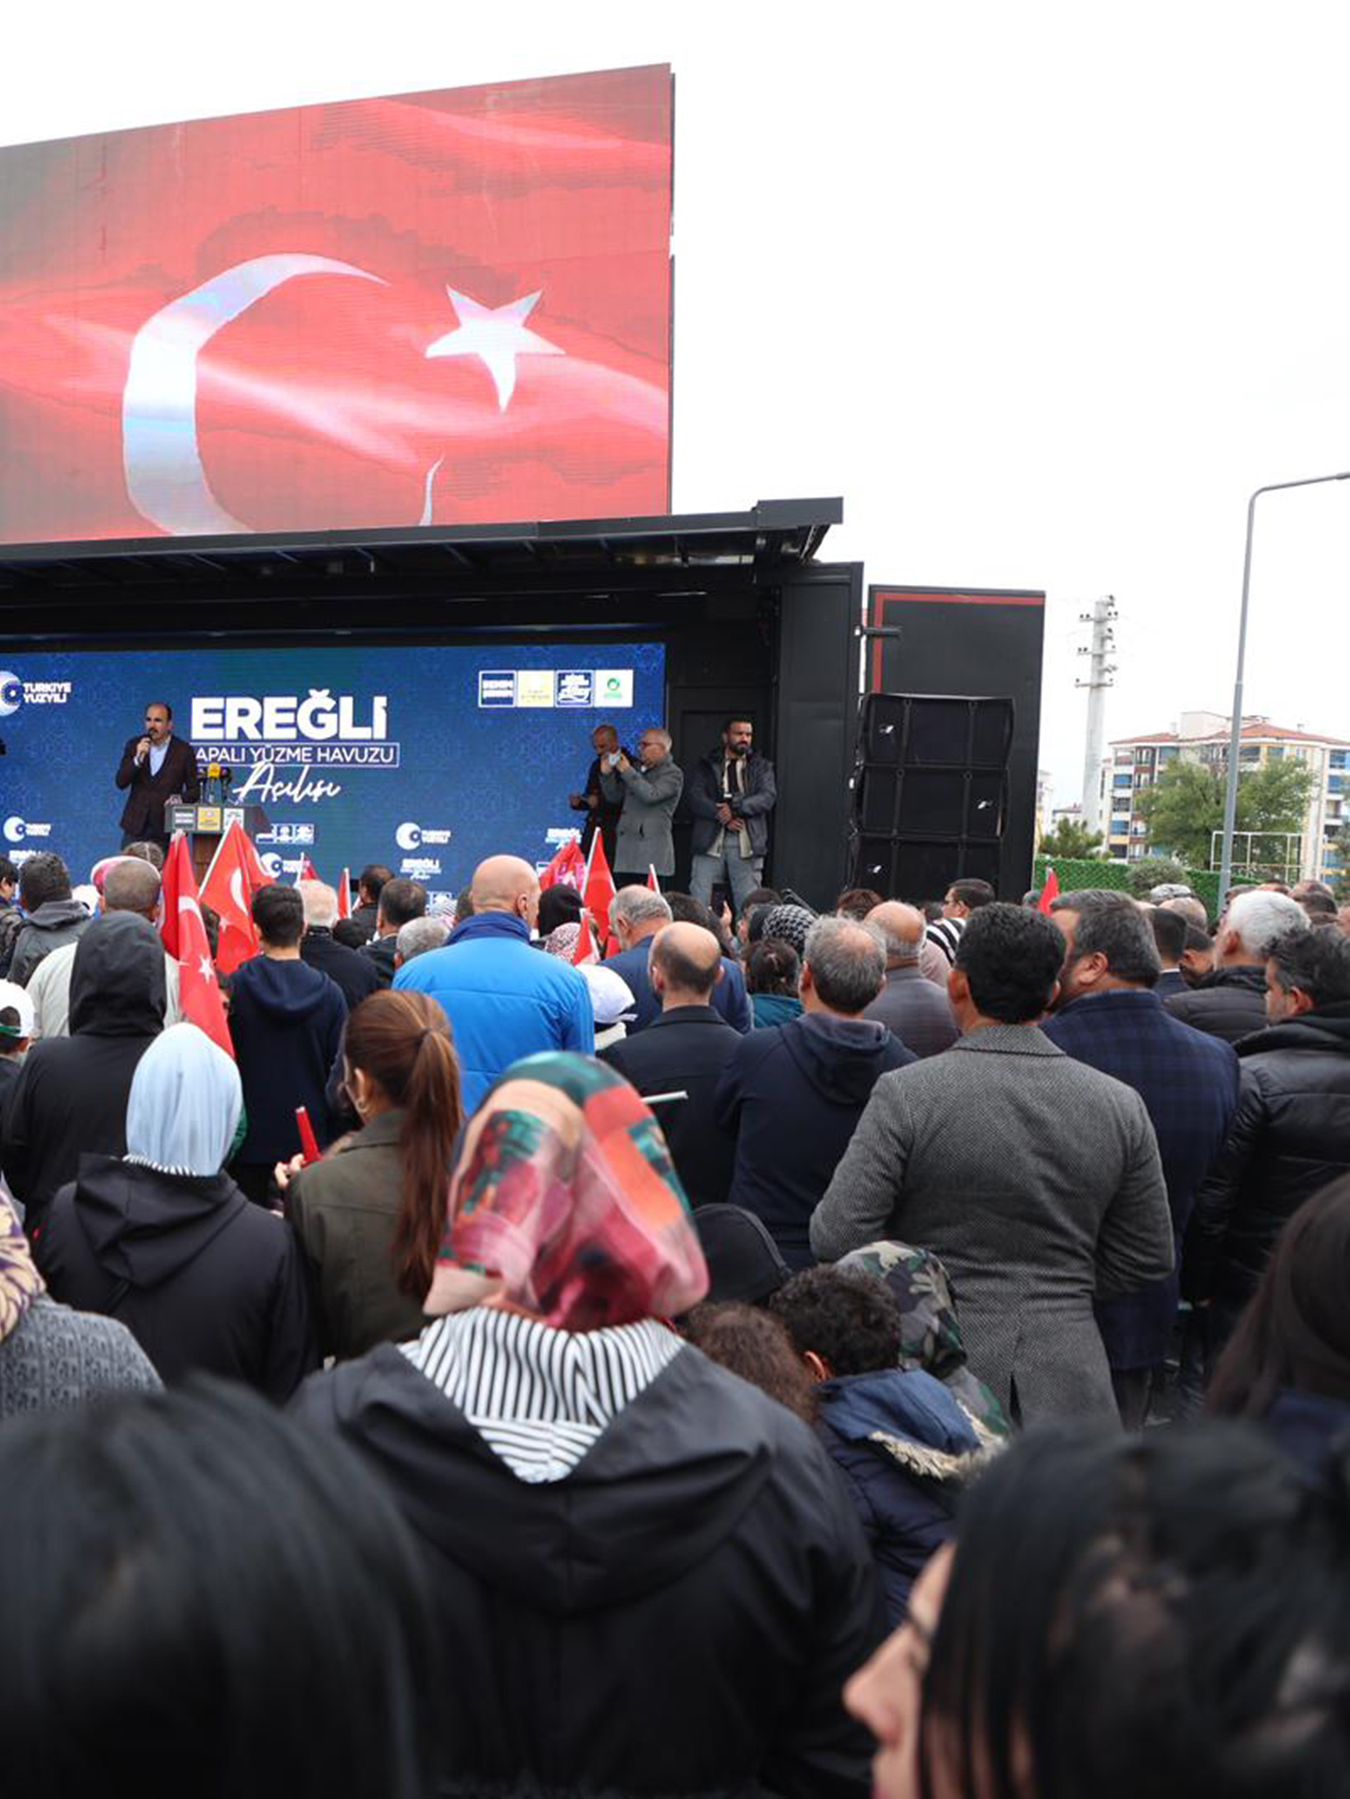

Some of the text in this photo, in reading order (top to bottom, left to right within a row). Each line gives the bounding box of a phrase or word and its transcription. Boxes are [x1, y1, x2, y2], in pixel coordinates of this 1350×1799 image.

[195, 744, 395, 763] APALI YÜZME HAVUZU
